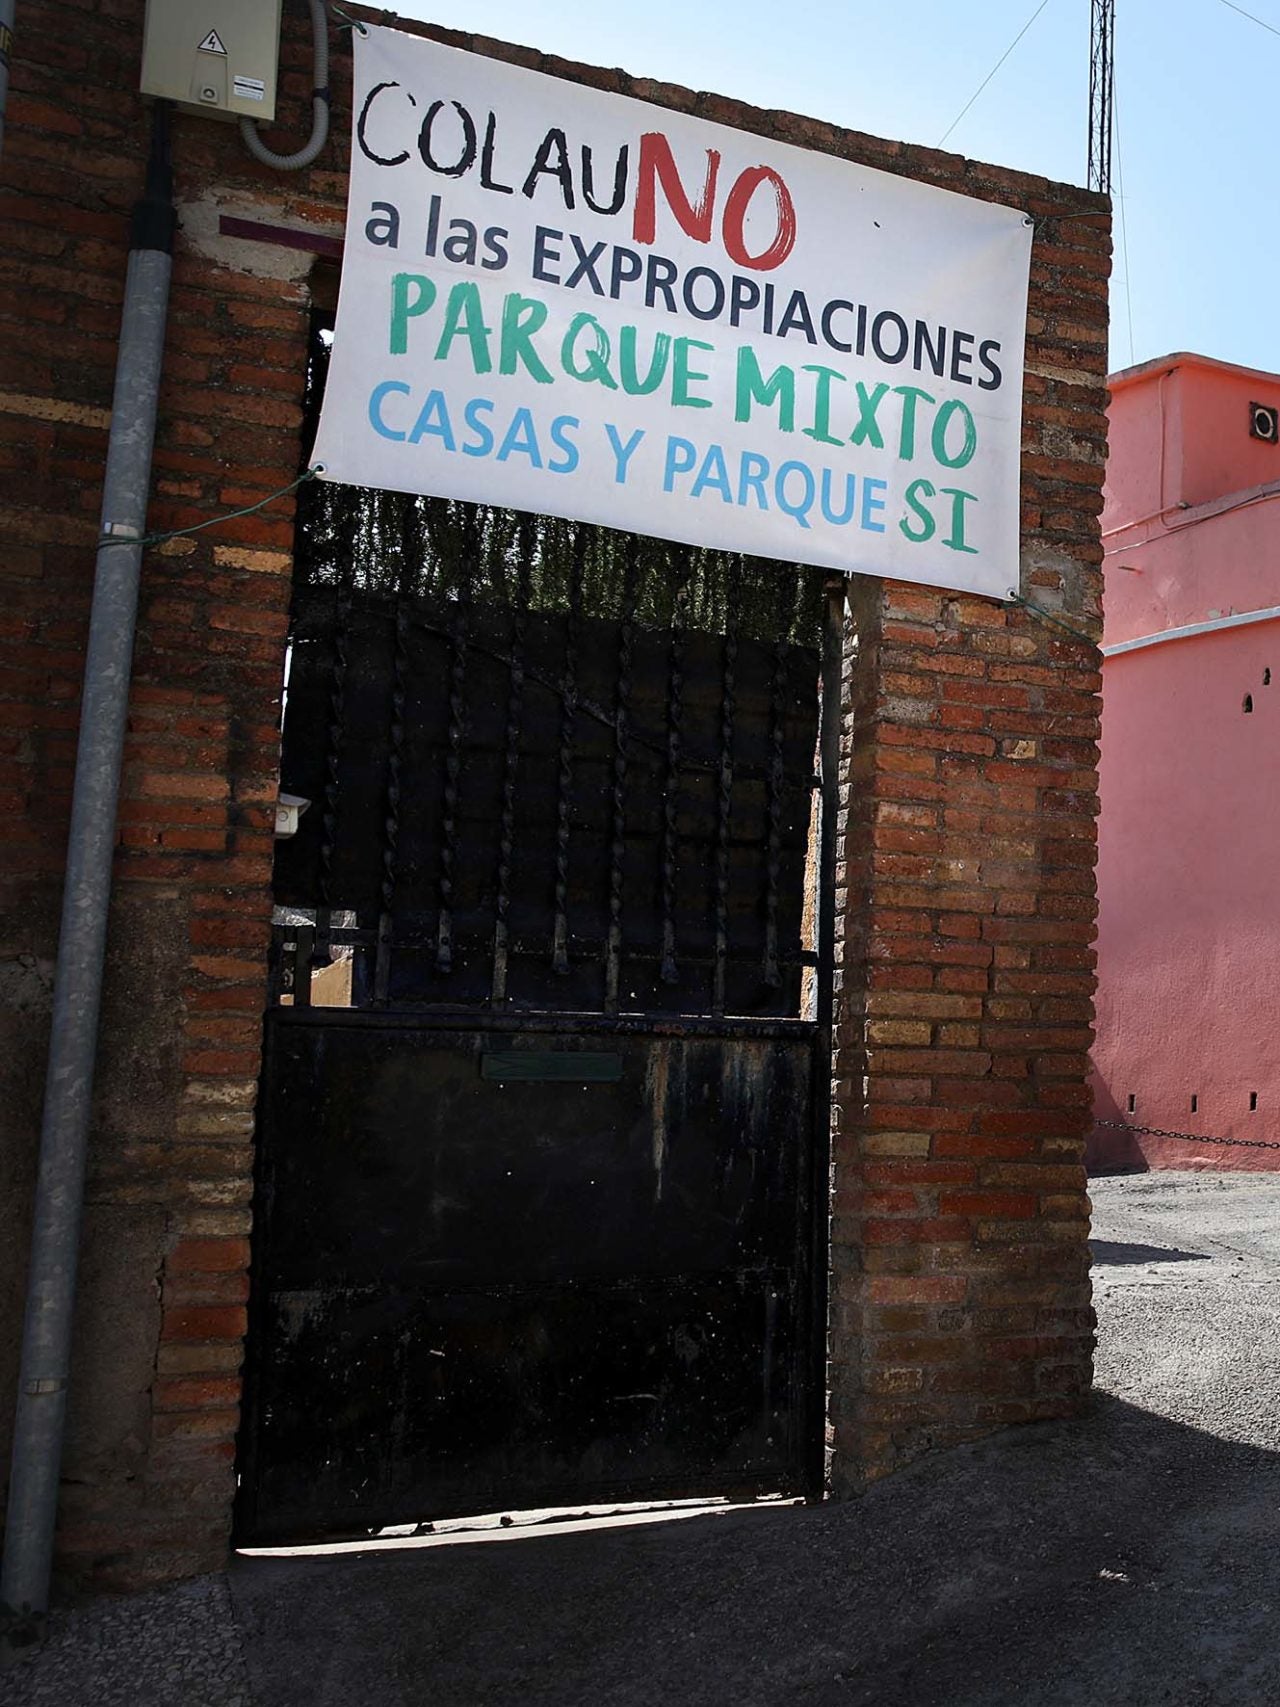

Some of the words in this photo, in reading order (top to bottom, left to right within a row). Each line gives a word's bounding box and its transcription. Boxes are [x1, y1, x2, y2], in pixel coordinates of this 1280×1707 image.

[357, 81, 630, 216] COLAU
[633, 131, 797, 272] NO
[365, 201, 400, 249] a
[425, 195, 508, 270] las
[532, 225, 1003, 391] EXPROPIACIONES
[390, 272, 714, 409] PARQUE
[735, 345, 978, 469] MIXTO
[368, 380, 580, 474] CASAS
[605, 424, 645, 484] Y
[663, 436, 887, 533] PARQUE
[898, 478, 979, 555] SI
